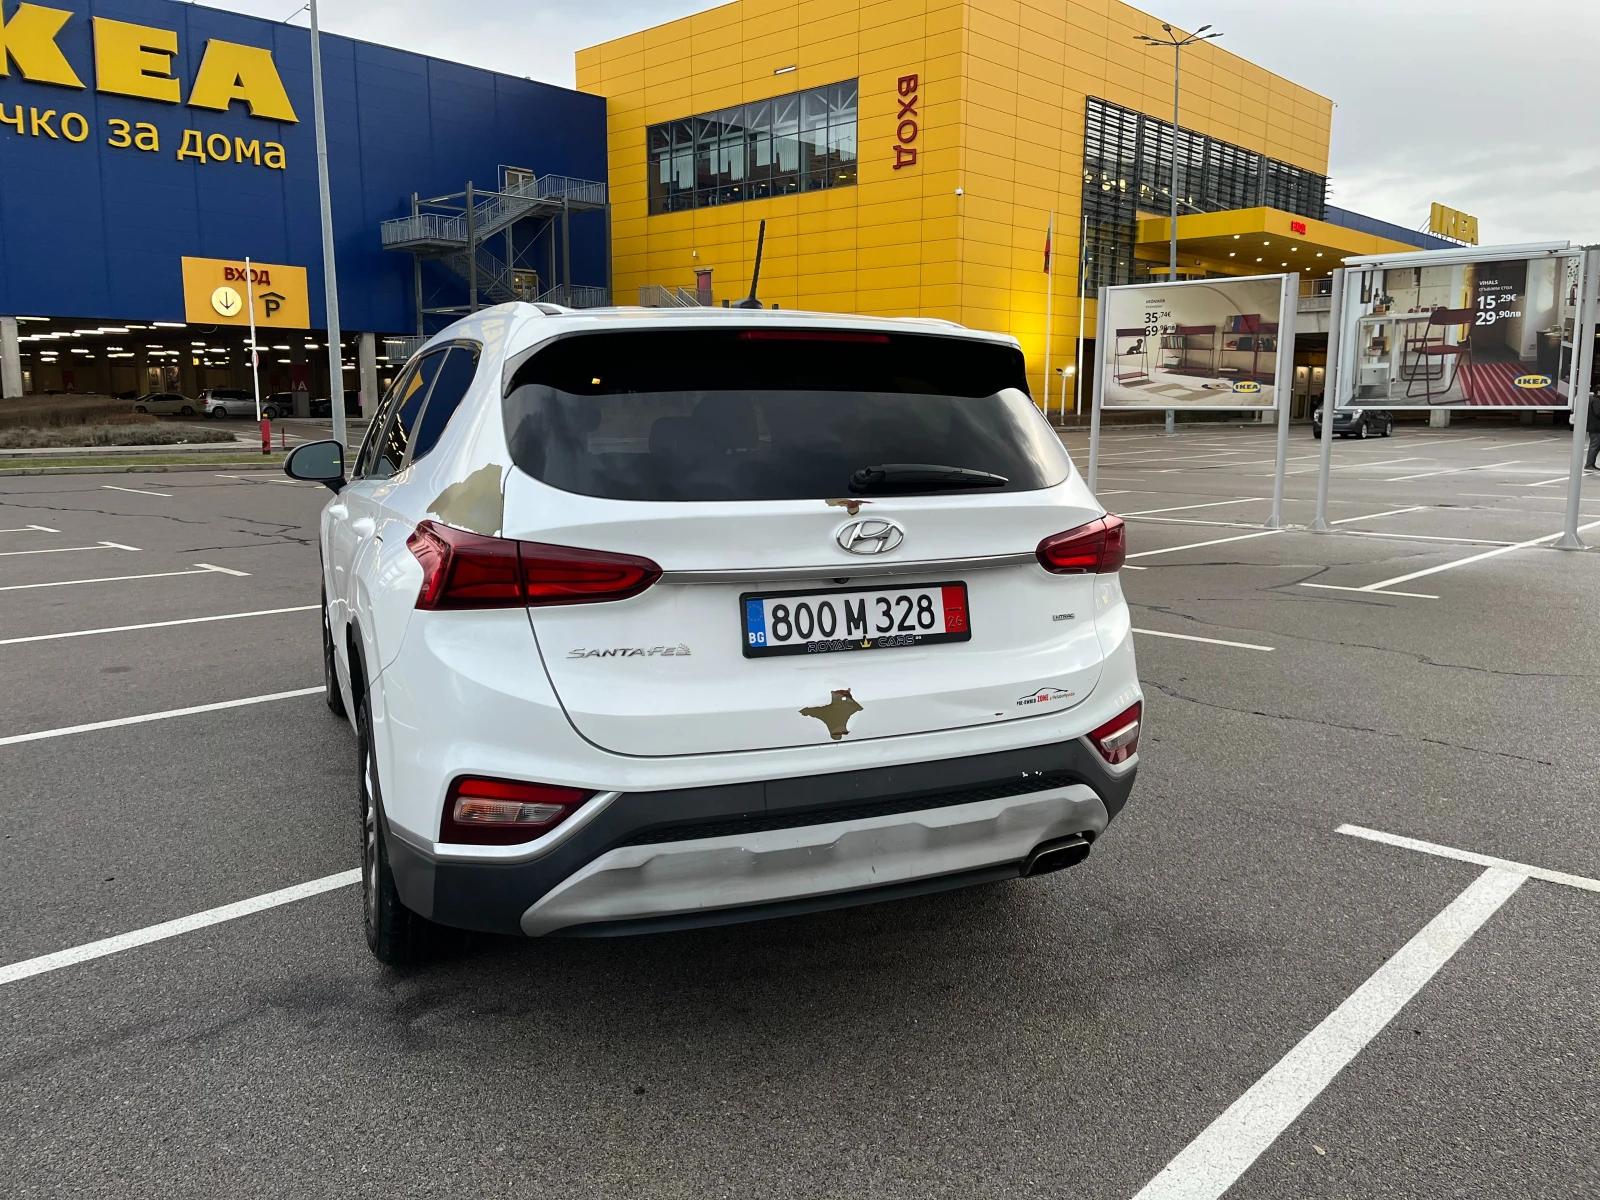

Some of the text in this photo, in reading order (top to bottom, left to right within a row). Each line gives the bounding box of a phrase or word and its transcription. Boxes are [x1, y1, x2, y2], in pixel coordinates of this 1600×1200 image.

[893, 74, 919, 170] ВХОД
[107, 118, 160, 152] за
[177, 129, 287, 170] дома
[224, 267, 271, 286] ВХОД
[771, 594, 935, 641] 800 M 328
[749, 632, 765, 644] BG
[807, 634, 916, 653] ROYAL CARS
[566, 645, 676, 659] SANTA FE
[1037, 694, 1049, 703] ZONE
